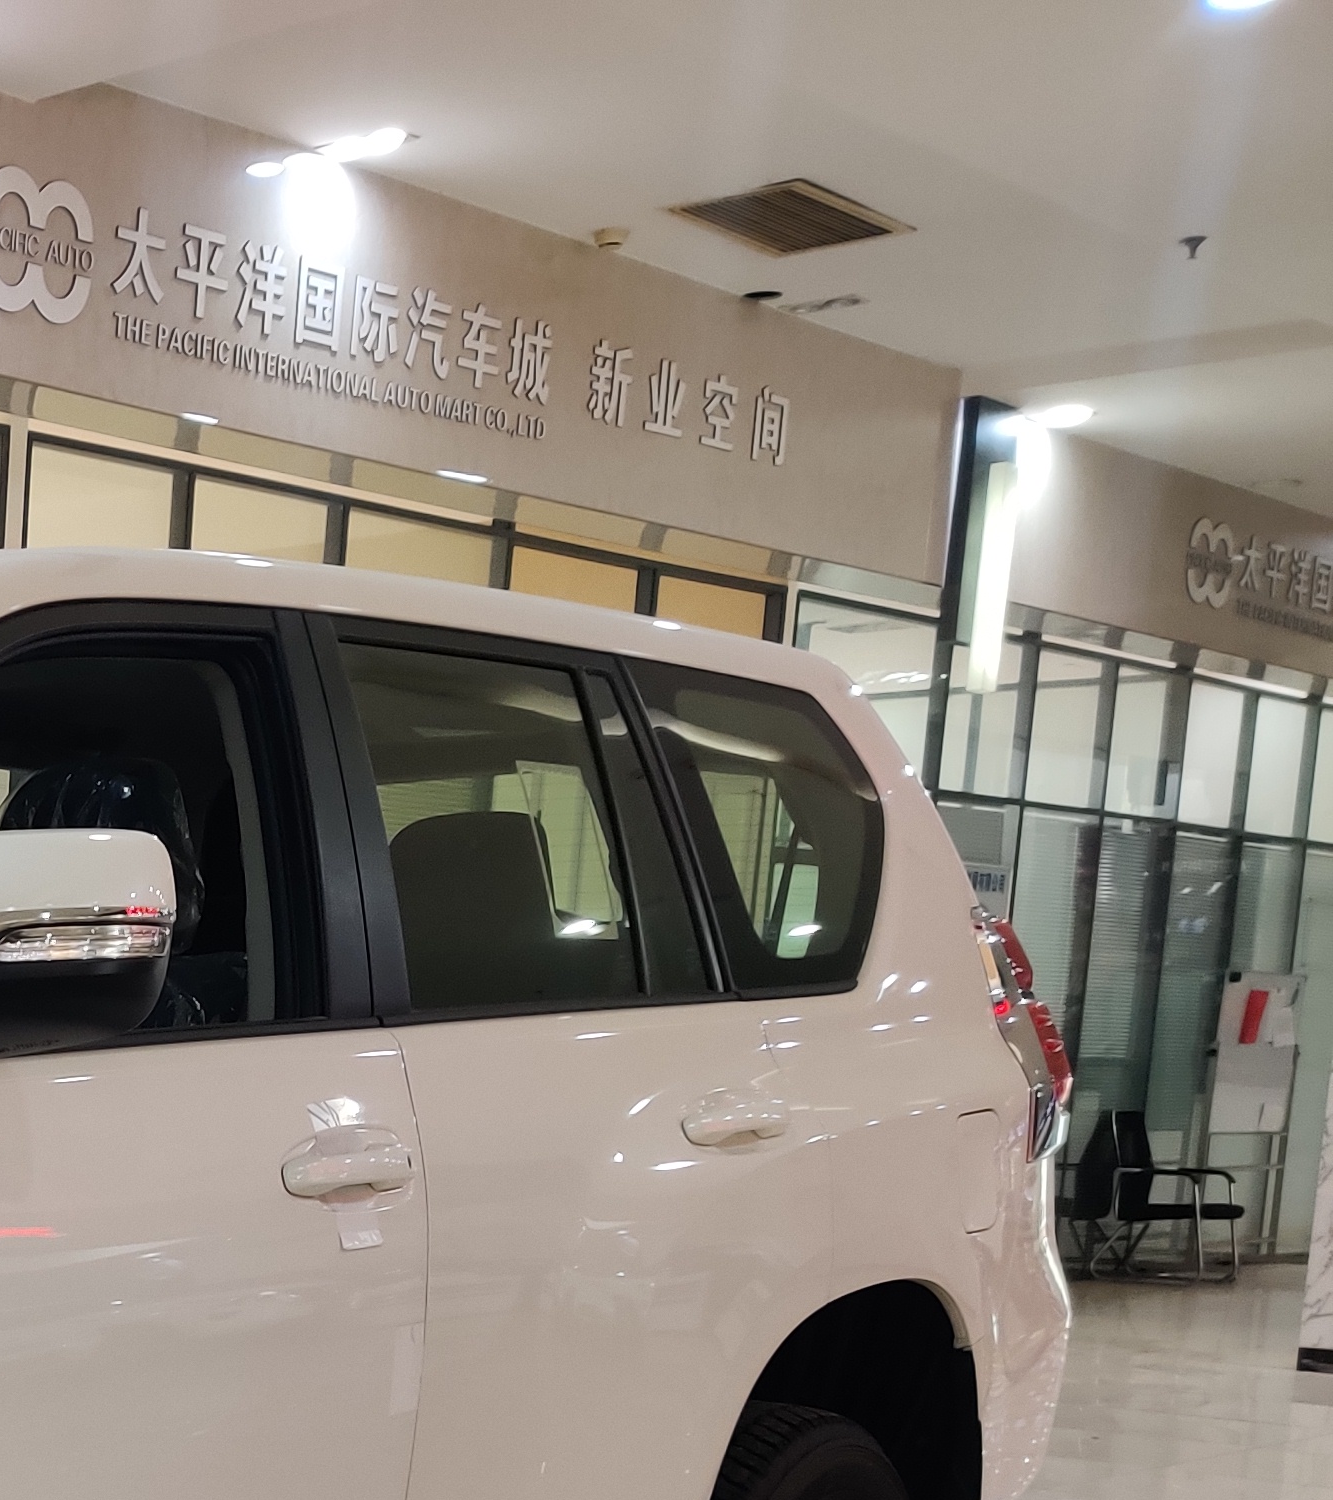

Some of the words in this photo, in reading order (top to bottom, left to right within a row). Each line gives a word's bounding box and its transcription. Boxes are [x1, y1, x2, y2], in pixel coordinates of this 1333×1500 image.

[45, 239, 94, 272] AUTO
[111, 206, 552, 405] 太平洋国际汽车城
[587, 338, 790, 467] 新业空间
[113, 312, 153, 346] THE
[157, 322, 230, 366] PACIFIC
[234, 343, 380, 402] INTERNATIONAL
[383, 381, 432, 414] AUTO
[435, 394, 483, 425] MART
[1239, 534, 1332, 614] 太平洋国
